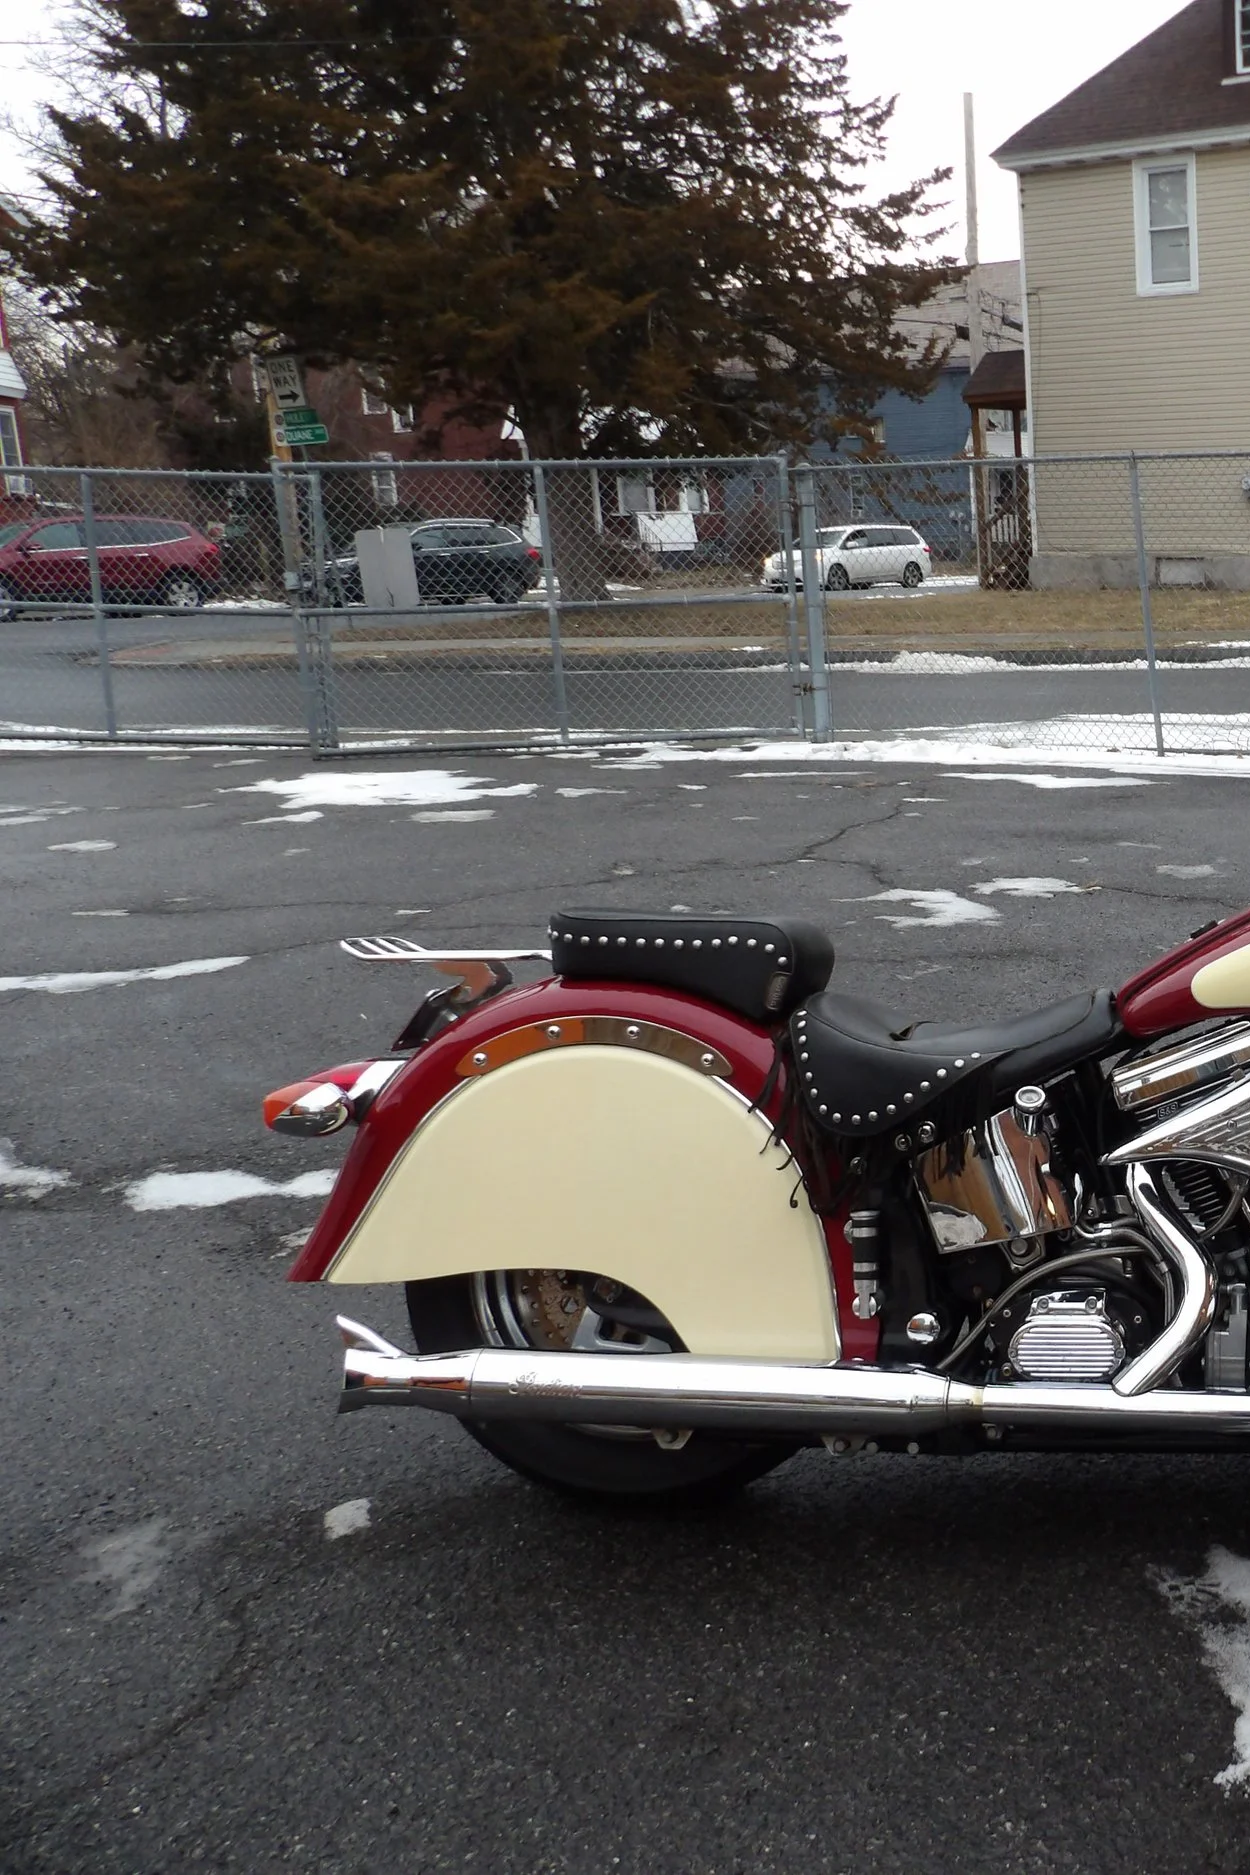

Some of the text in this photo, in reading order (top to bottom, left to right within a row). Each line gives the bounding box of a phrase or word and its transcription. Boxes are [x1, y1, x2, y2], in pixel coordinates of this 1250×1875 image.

[270, 359, 295, 374] ONE
[272, 374, 298, 389] WAY
[285, 429, 315, 441] DUANE
[1159, 1102, 1177, 1118] S&S
